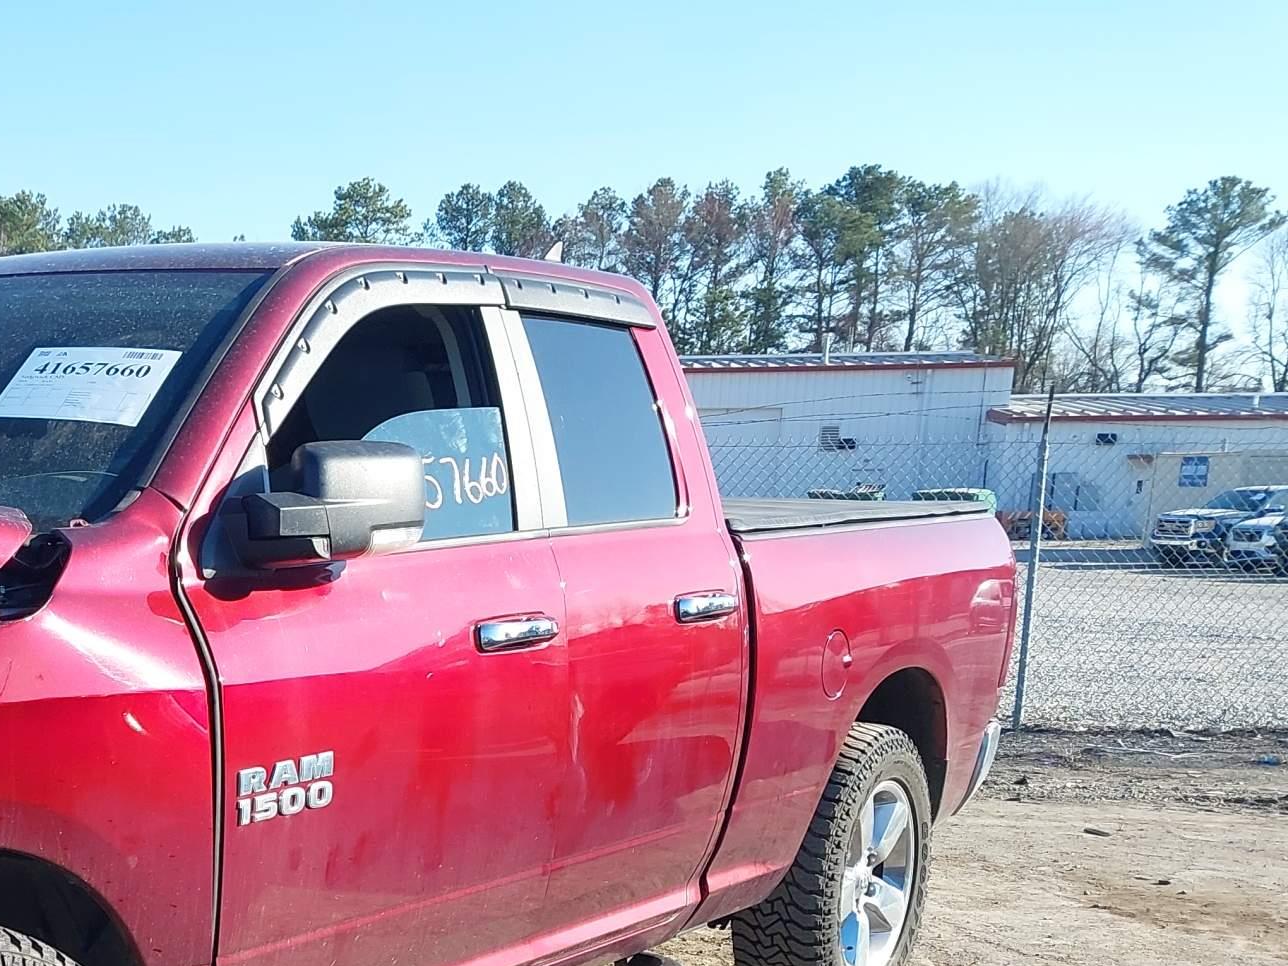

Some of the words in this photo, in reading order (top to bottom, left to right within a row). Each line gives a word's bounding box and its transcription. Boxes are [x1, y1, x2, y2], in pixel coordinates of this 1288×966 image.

[33, 361, 152, 379] 41657660
[237, 750, 335, 797] RAM
[237, 780, 334, 827] 1500
